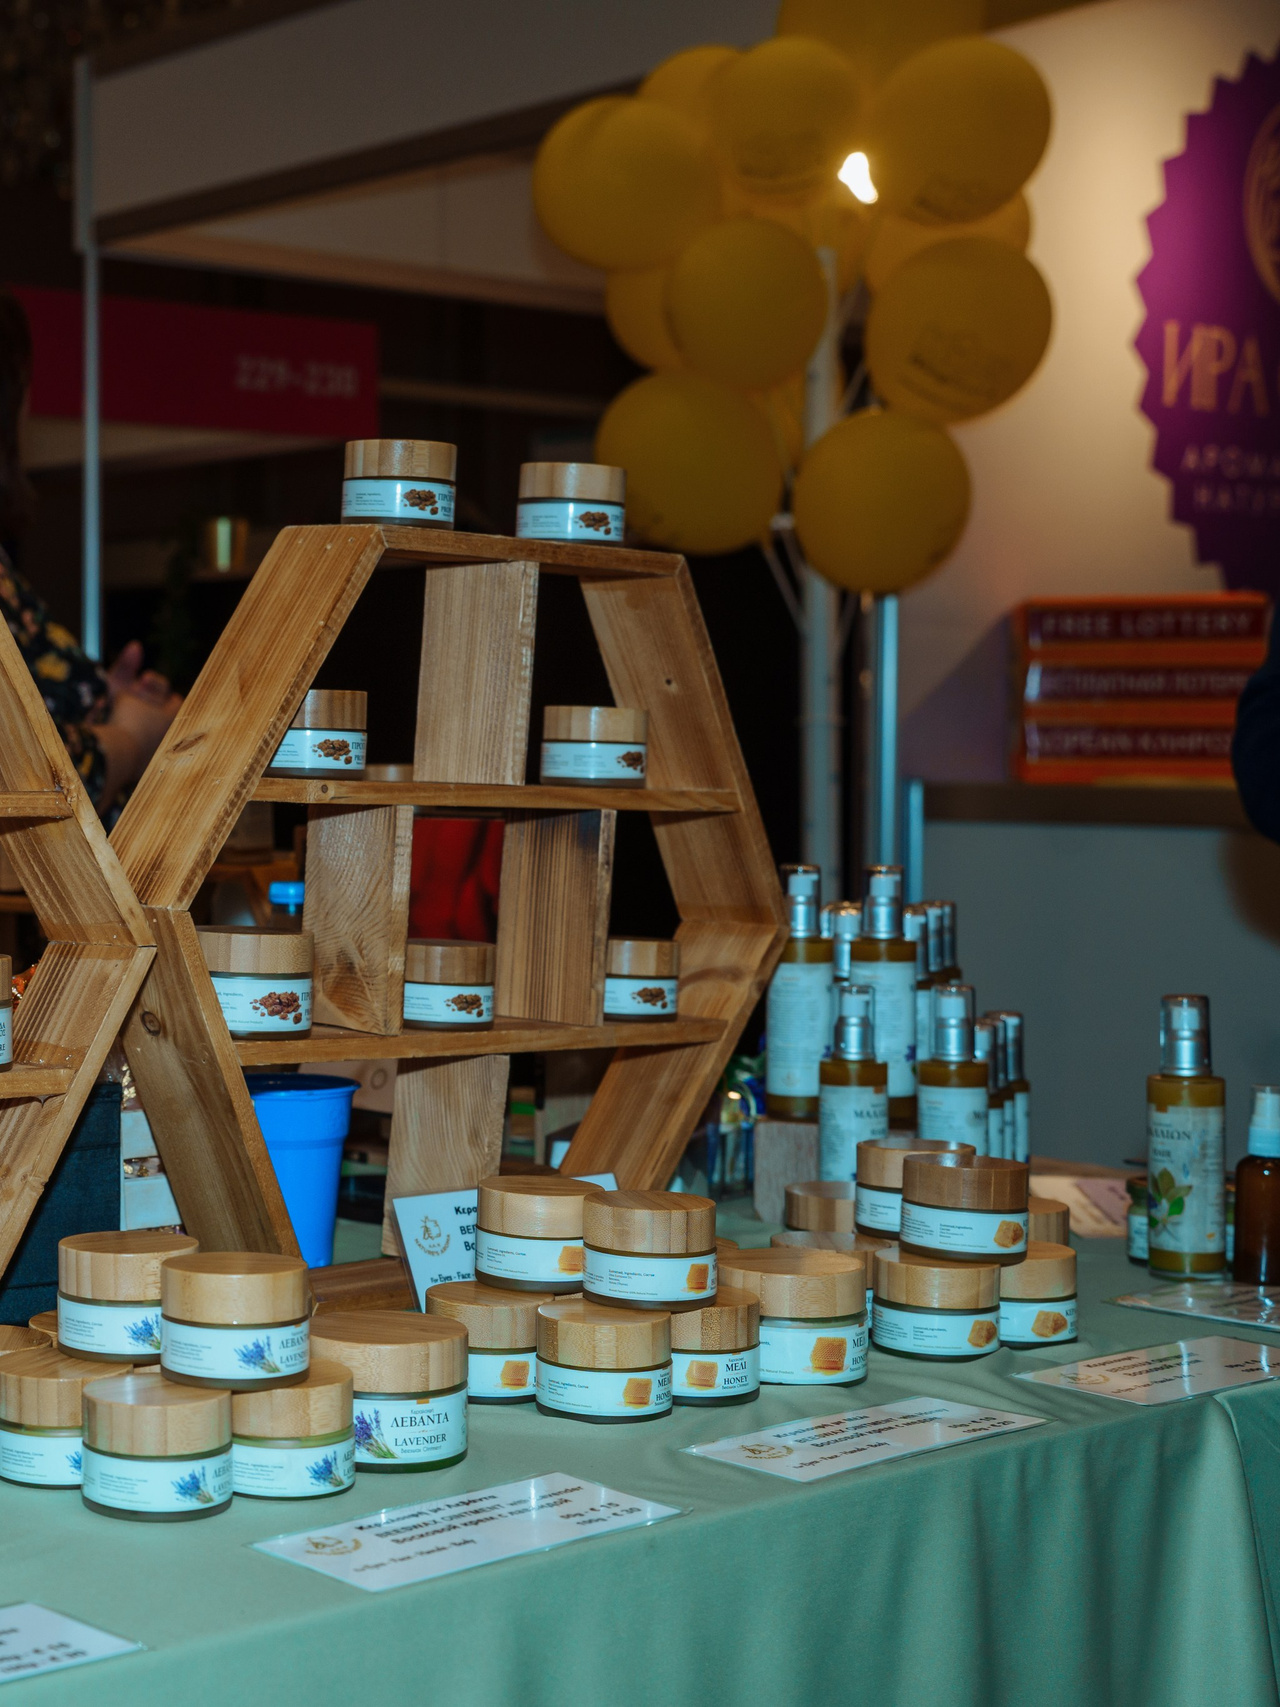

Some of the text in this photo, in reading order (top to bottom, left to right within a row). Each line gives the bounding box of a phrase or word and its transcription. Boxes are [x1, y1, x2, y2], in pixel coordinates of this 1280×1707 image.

[454, 1206, 478, 1216] Κερα
[438, 1273, 452, 1283] Eyes
[457, 1271, 470, 1280] Face
[725, 1361, 747, 1372] ΜΕΛΙ
[723, 1374, 748, 1385] HONEY
[390, 1412, 449, 1428] ΛΕΒΑΝΤΑ
[394, 1433, 447, 1446] LAVENDER
